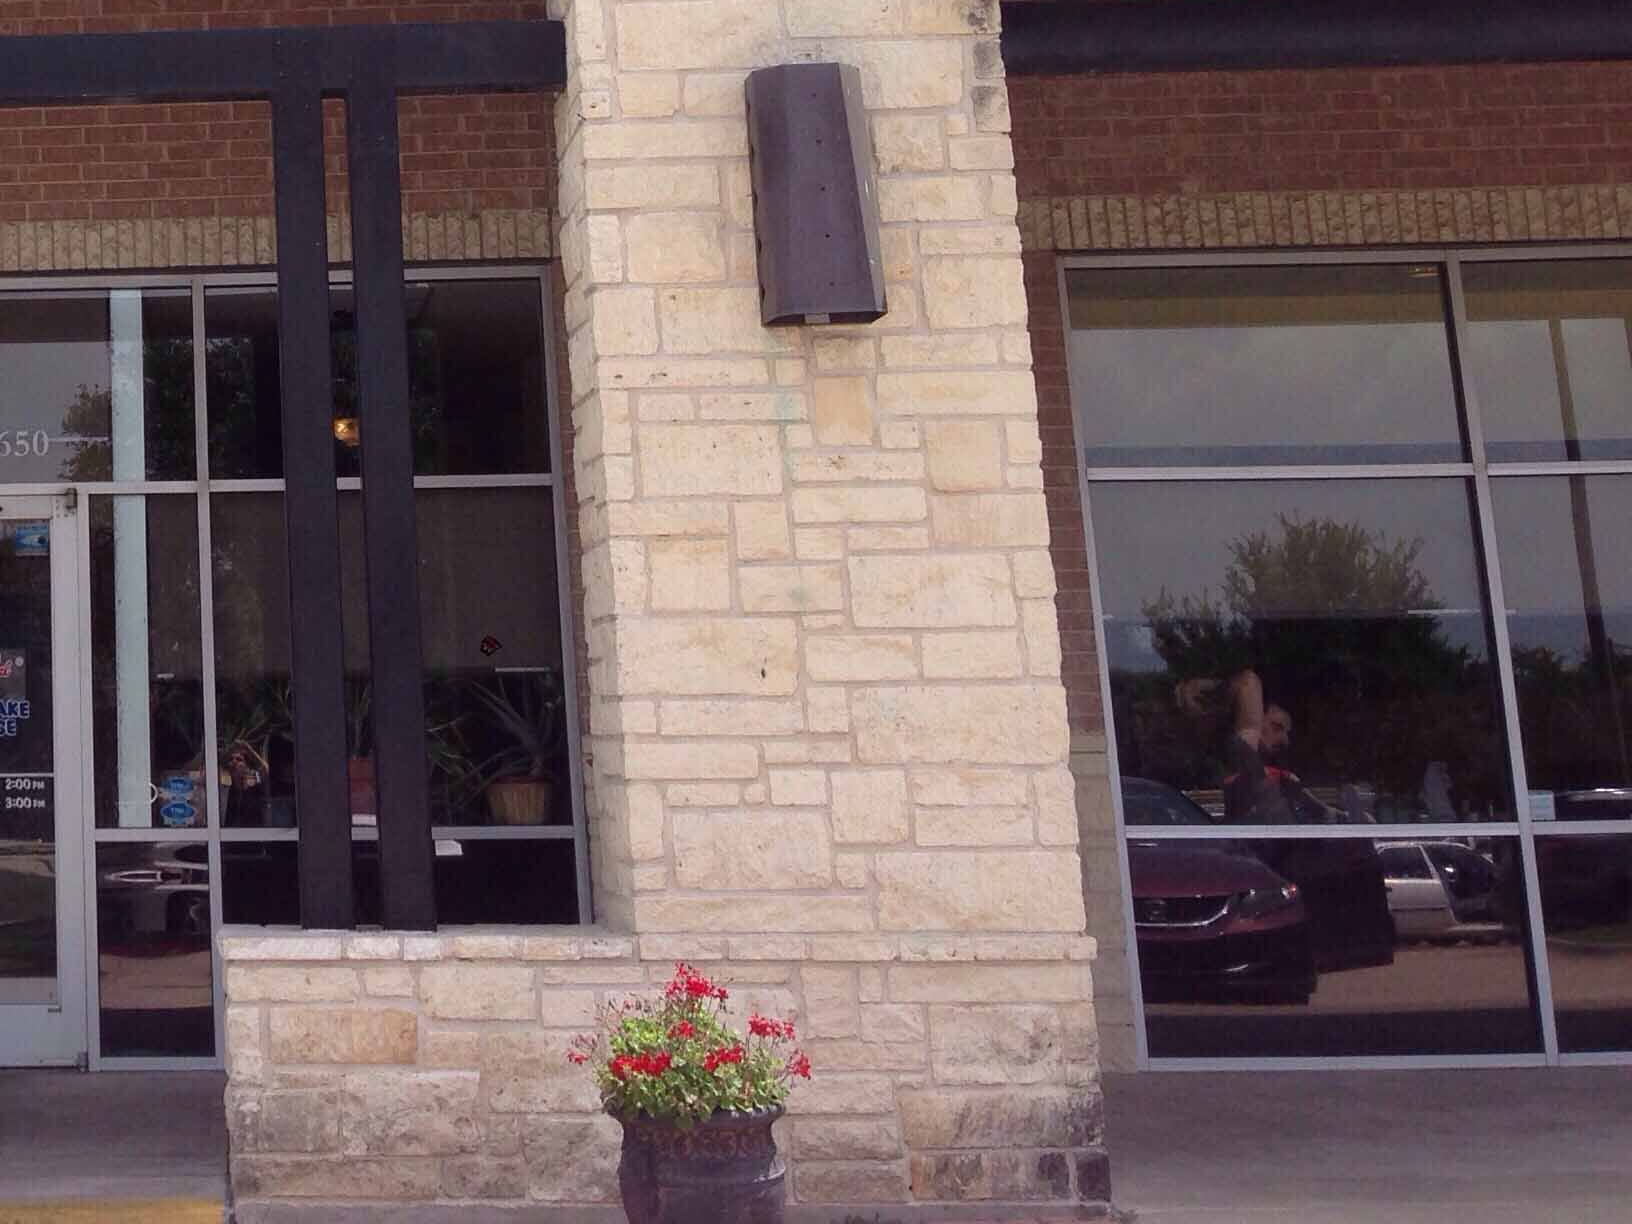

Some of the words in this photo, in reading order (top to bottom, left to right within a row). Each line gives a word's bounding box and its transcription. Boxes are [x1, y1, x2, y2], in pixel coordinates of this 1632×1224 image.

[5, 778, 31, 790] 2:00
[33, 780, 45, 790] PM
[5, 798, 31, 809] 3:00
[33, 799, 46, 809] PM
